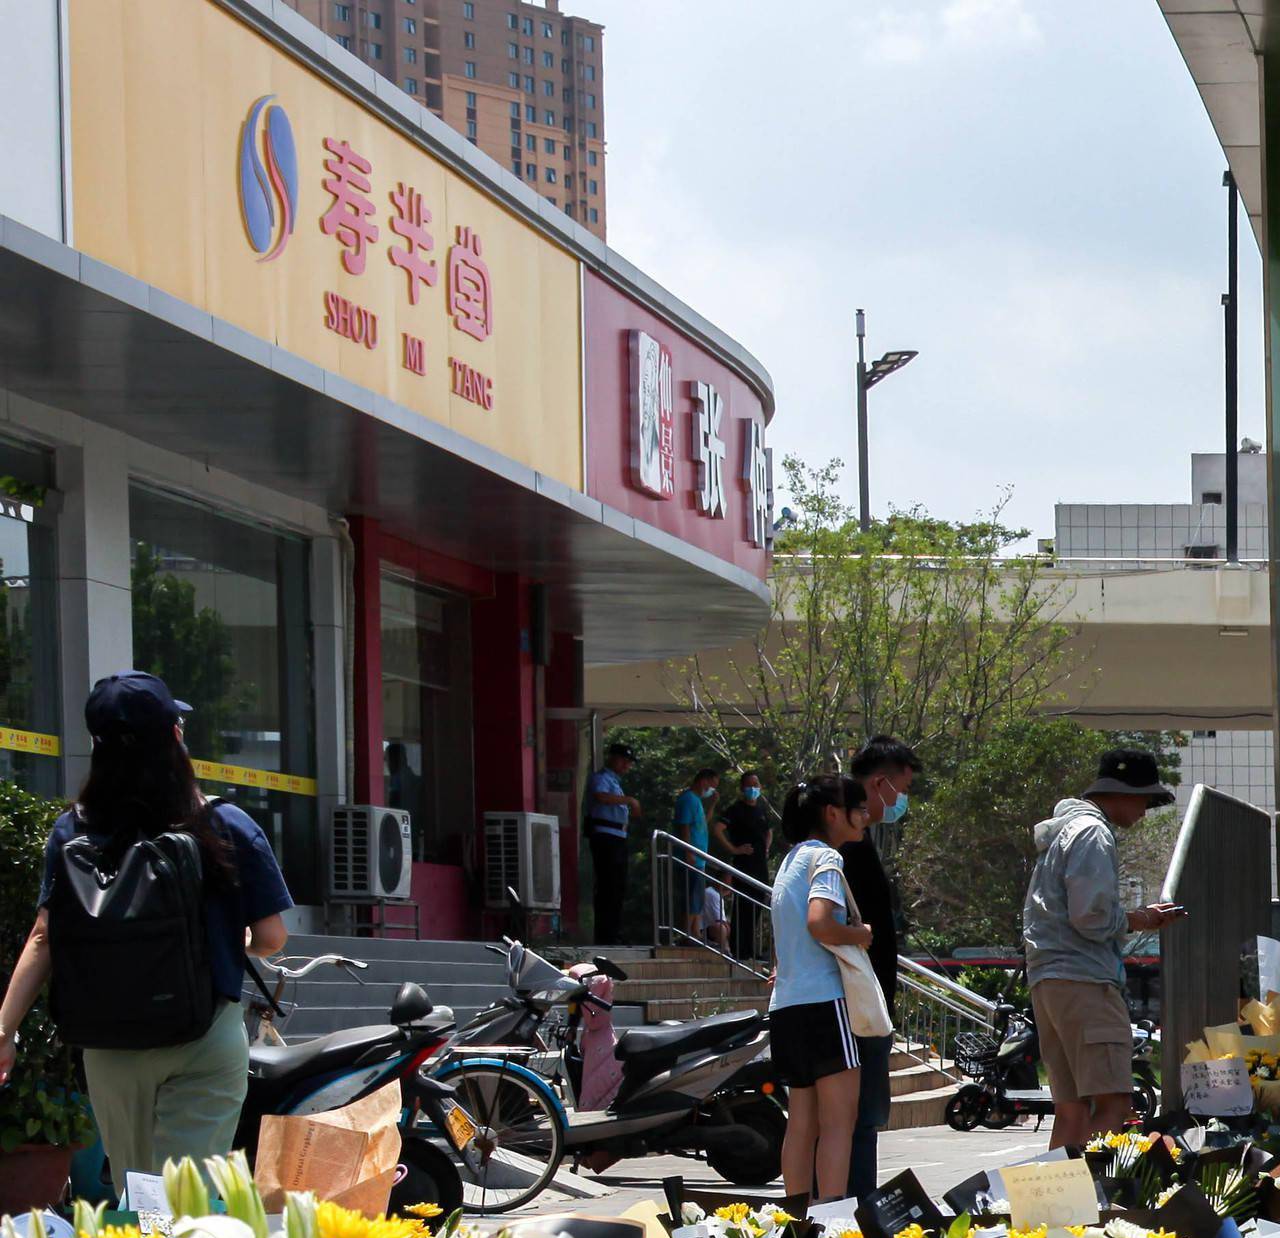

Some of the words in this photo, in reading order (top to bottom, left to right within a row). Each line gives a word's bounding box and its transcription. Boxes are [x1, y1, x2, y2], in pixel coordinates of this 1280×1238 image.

[324, 290, 379, 350] SHOU
[401, 332, 427, 376] MI
[448, 355, 494, 411] TANG
